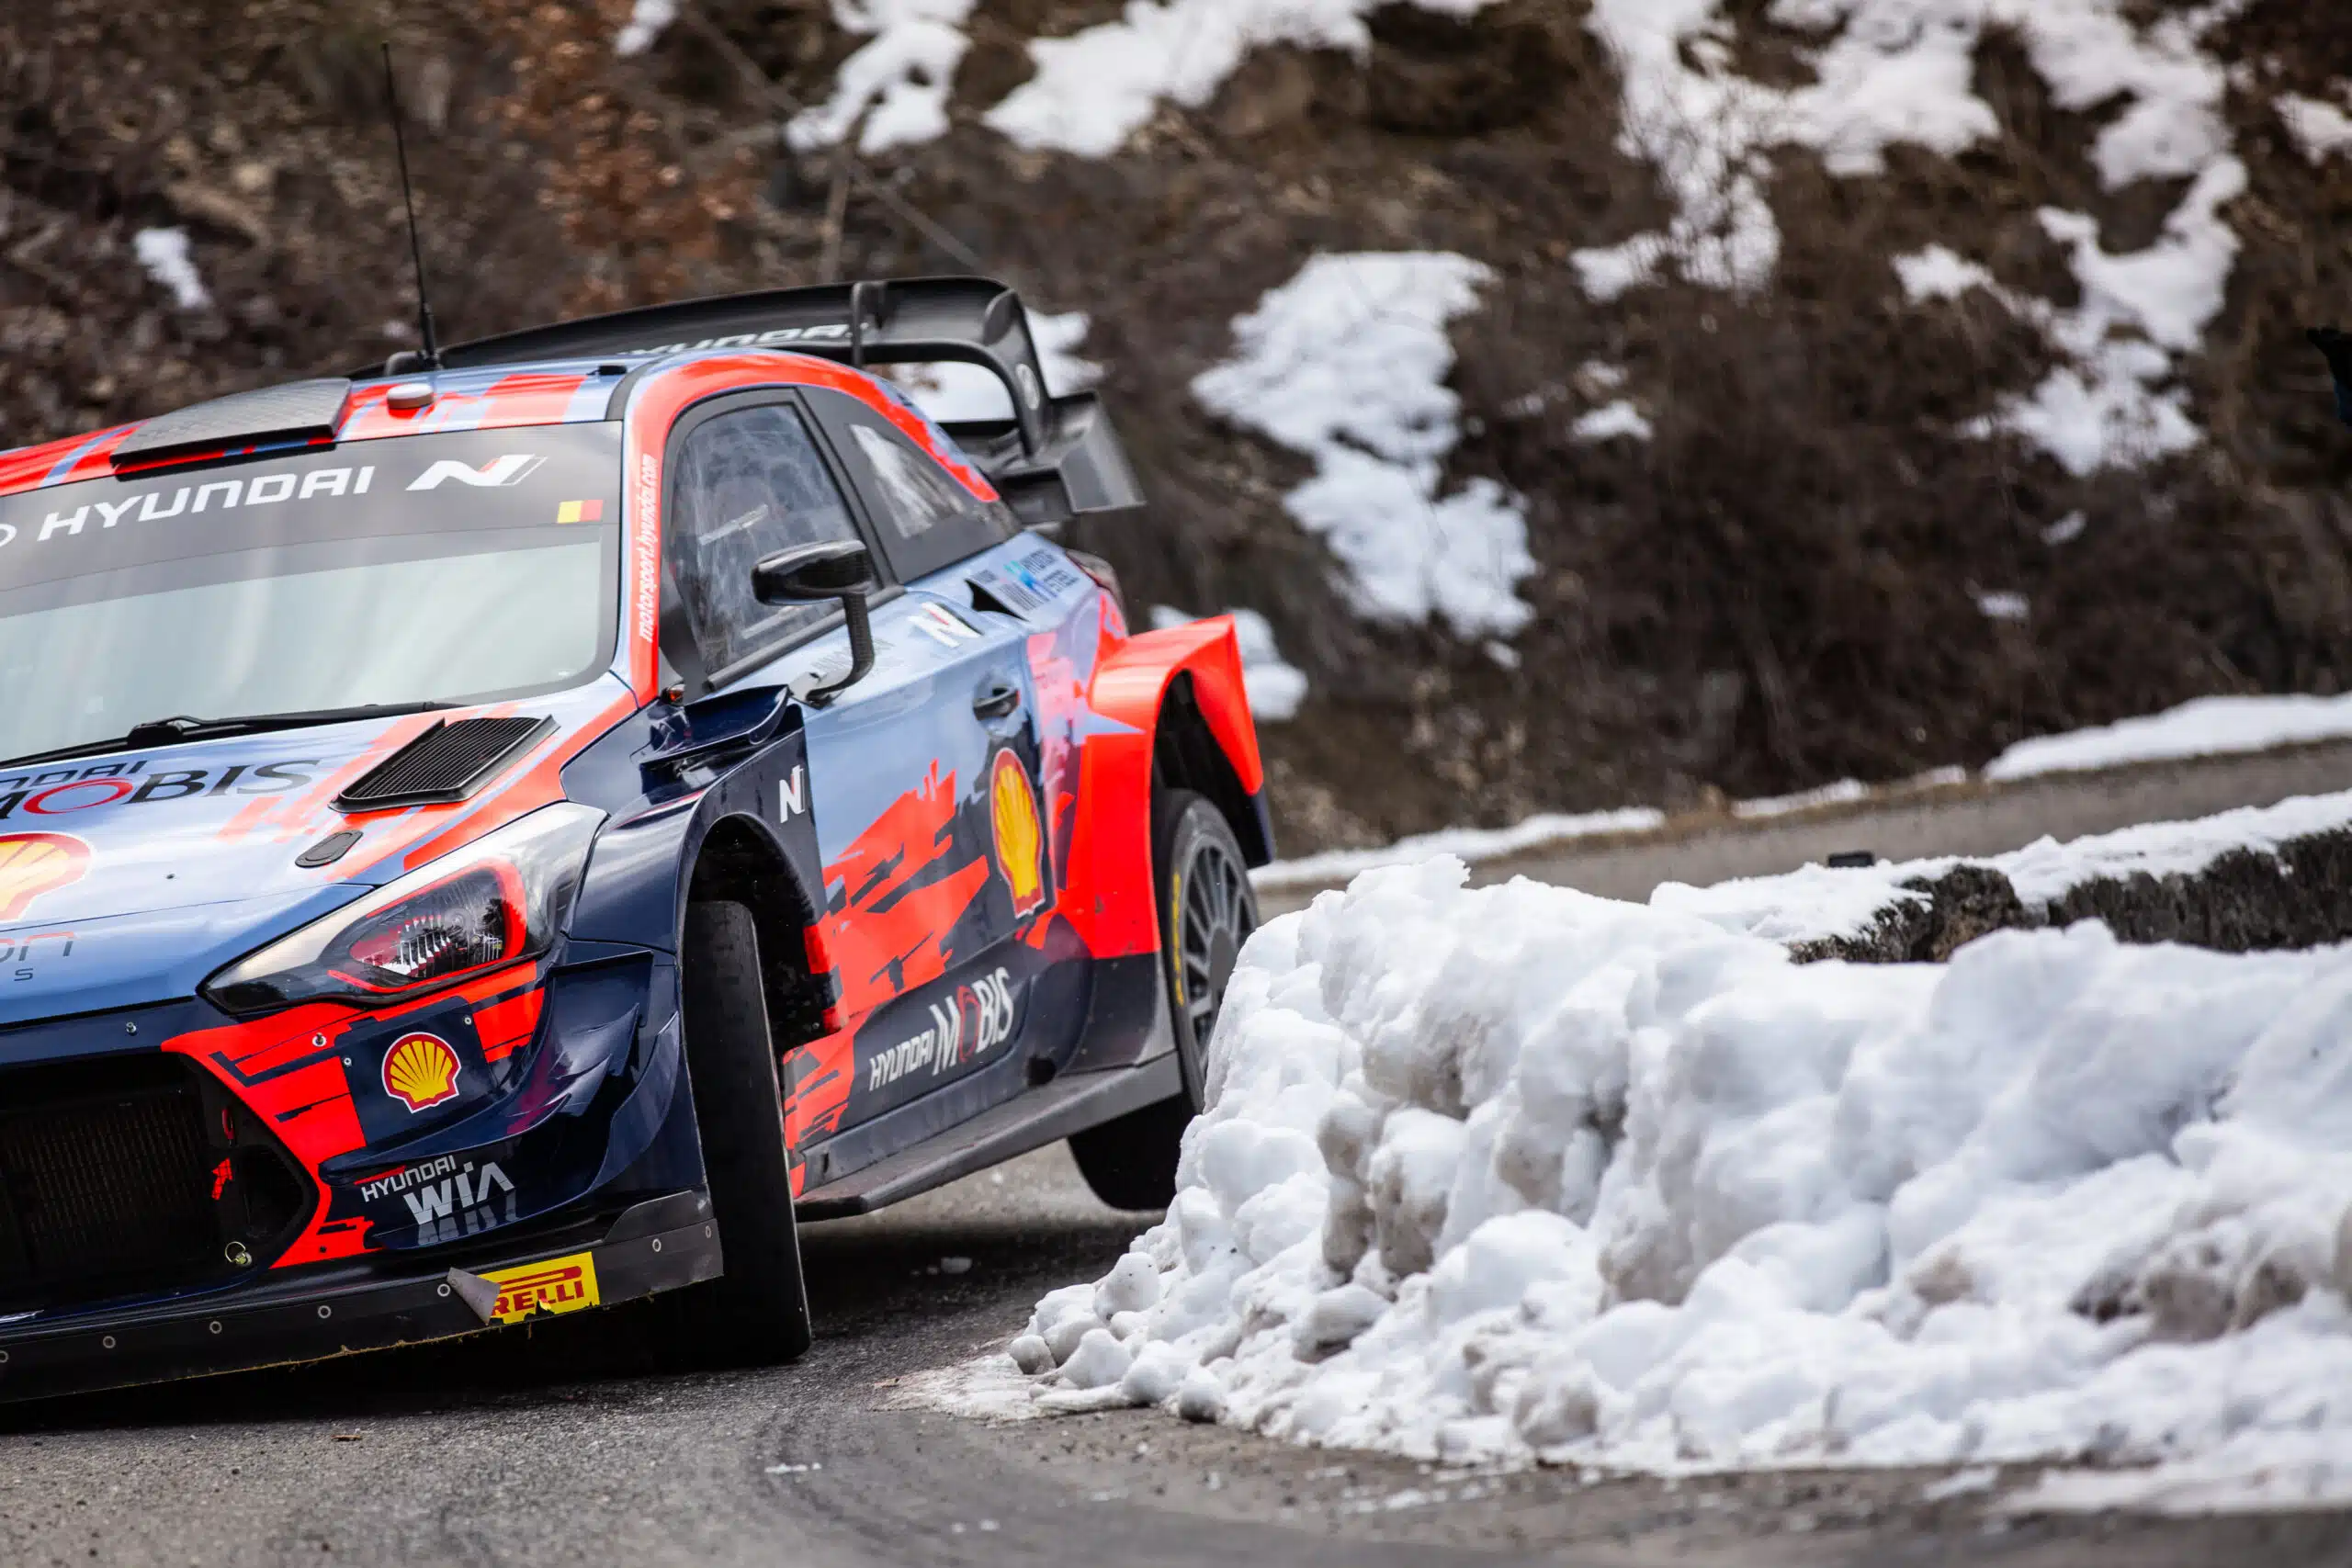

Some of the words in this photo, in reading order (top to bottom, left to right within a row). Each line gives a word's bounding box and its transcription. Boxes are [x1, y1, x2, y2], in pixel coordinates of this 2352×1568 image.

[37, 466, 375, 542] HYUNDAI
[404, 454, 548, 491] N
[636, 453, 658, 643] motorsport.hyundai.com
[868, 1029, 935, 1091] HYUNDAI
[929, 966, 1014, 1077] MOBIS
[361, 1155, 457, 1202] HYUNDAI
[492, 1266, 584, 1316] RELLI
